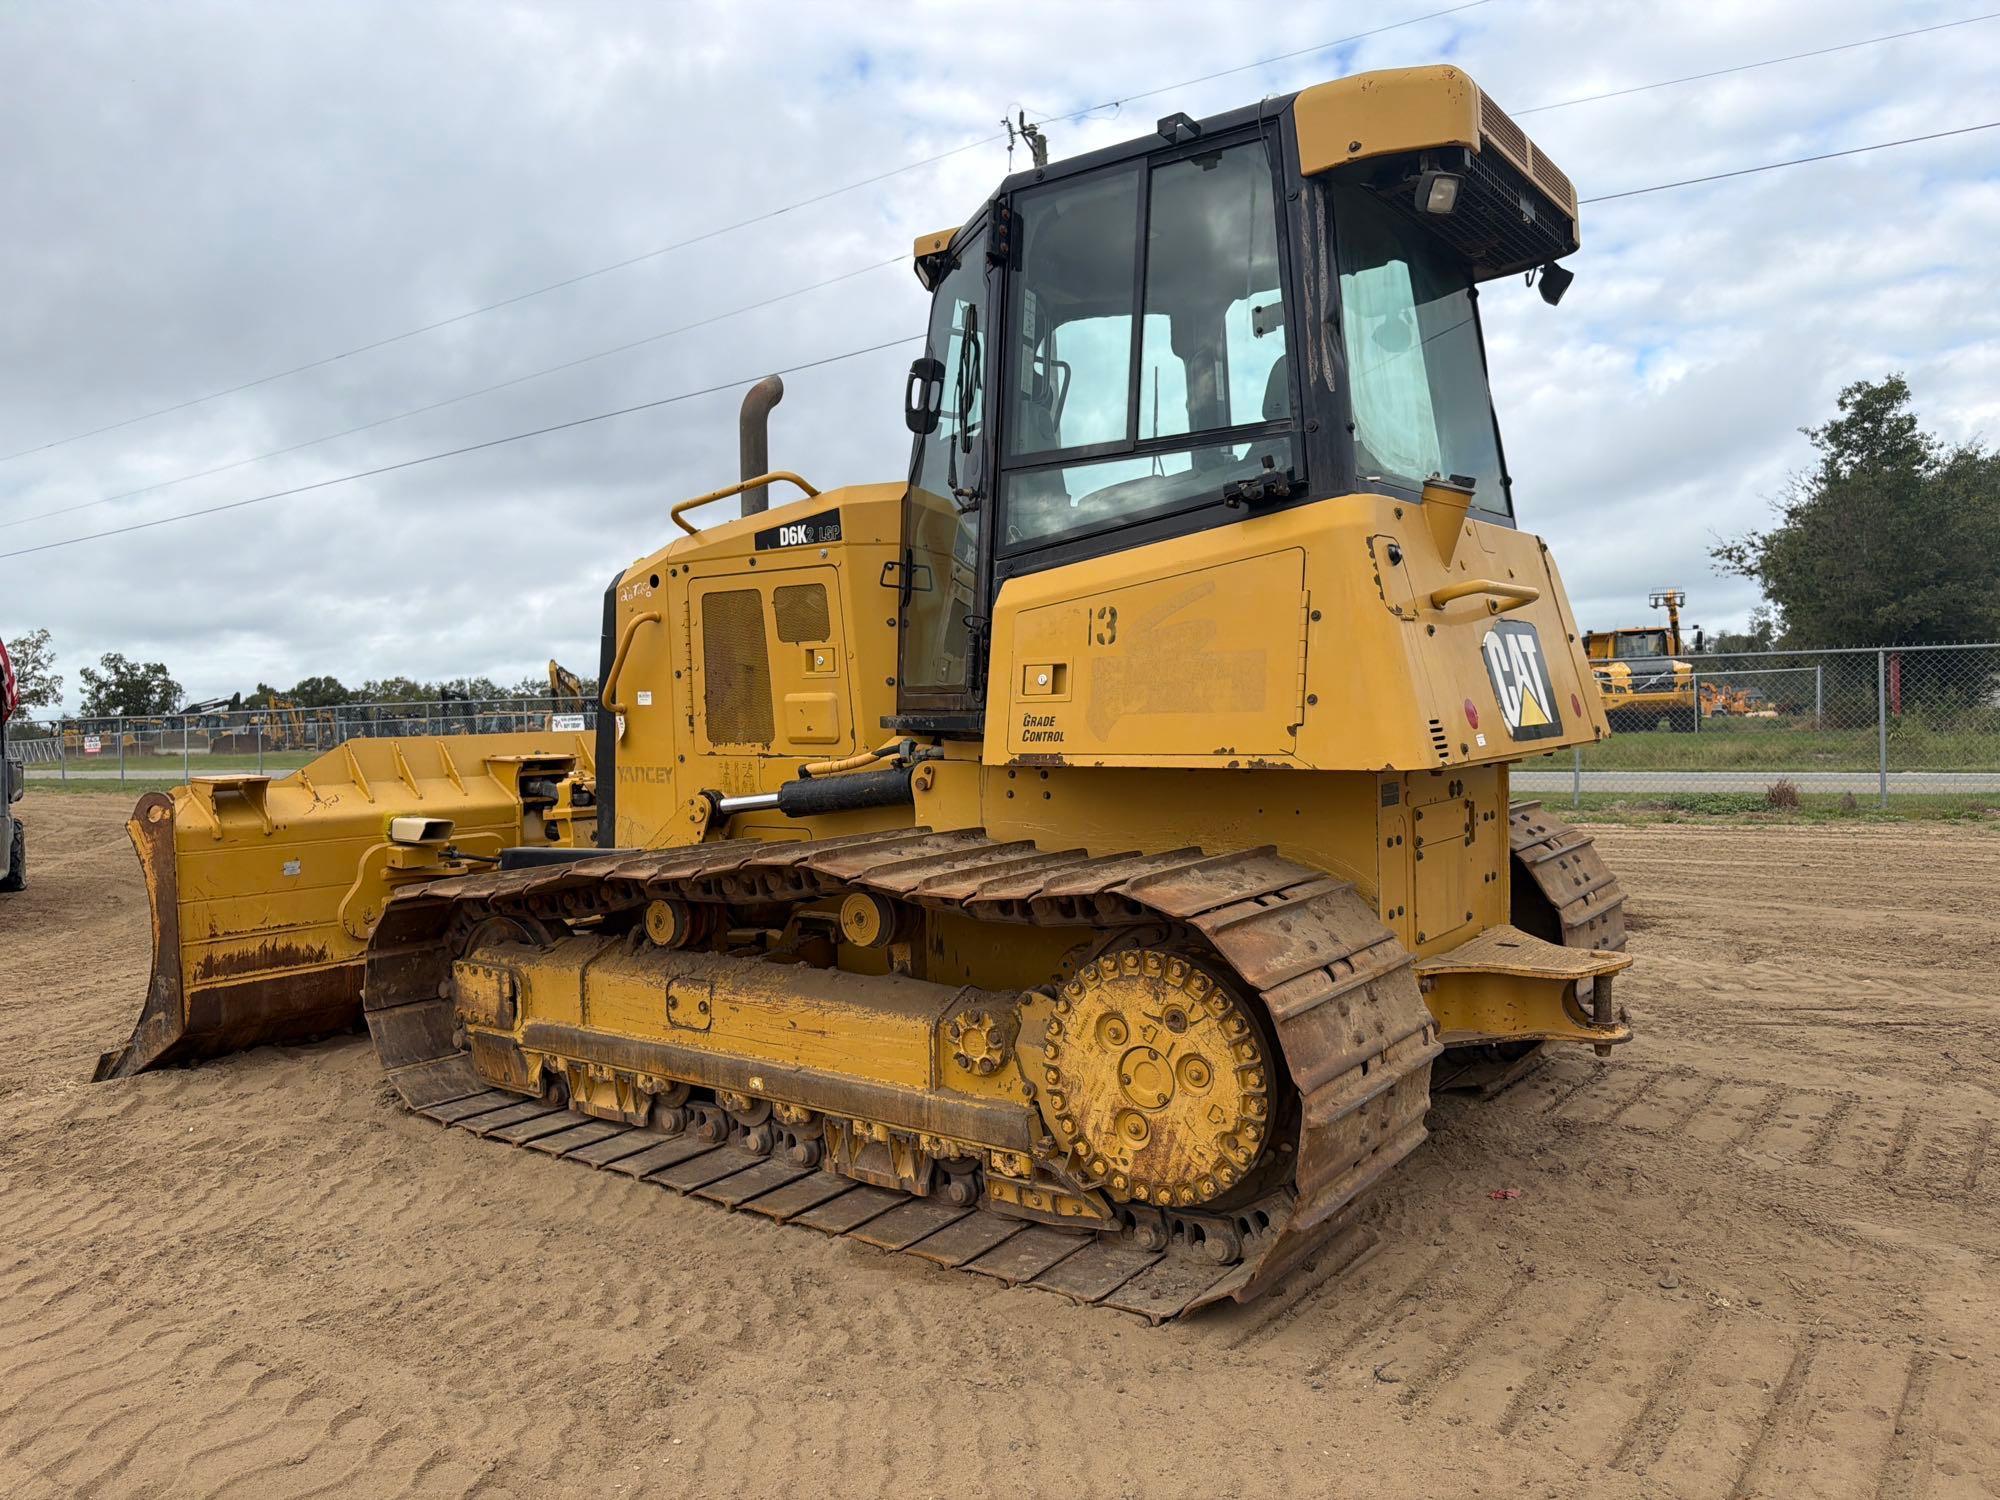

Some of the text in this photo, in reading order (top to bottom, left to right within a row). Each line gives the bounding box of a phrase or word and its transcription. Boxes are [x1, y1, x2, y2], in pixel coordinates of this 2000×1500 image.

[819, 525, 840, 542] LGP
[1088, 606, 1117, 646] 13
[1483, 631, 1553, 727] CAT
[616, 766, 673, 784] YANCEY
